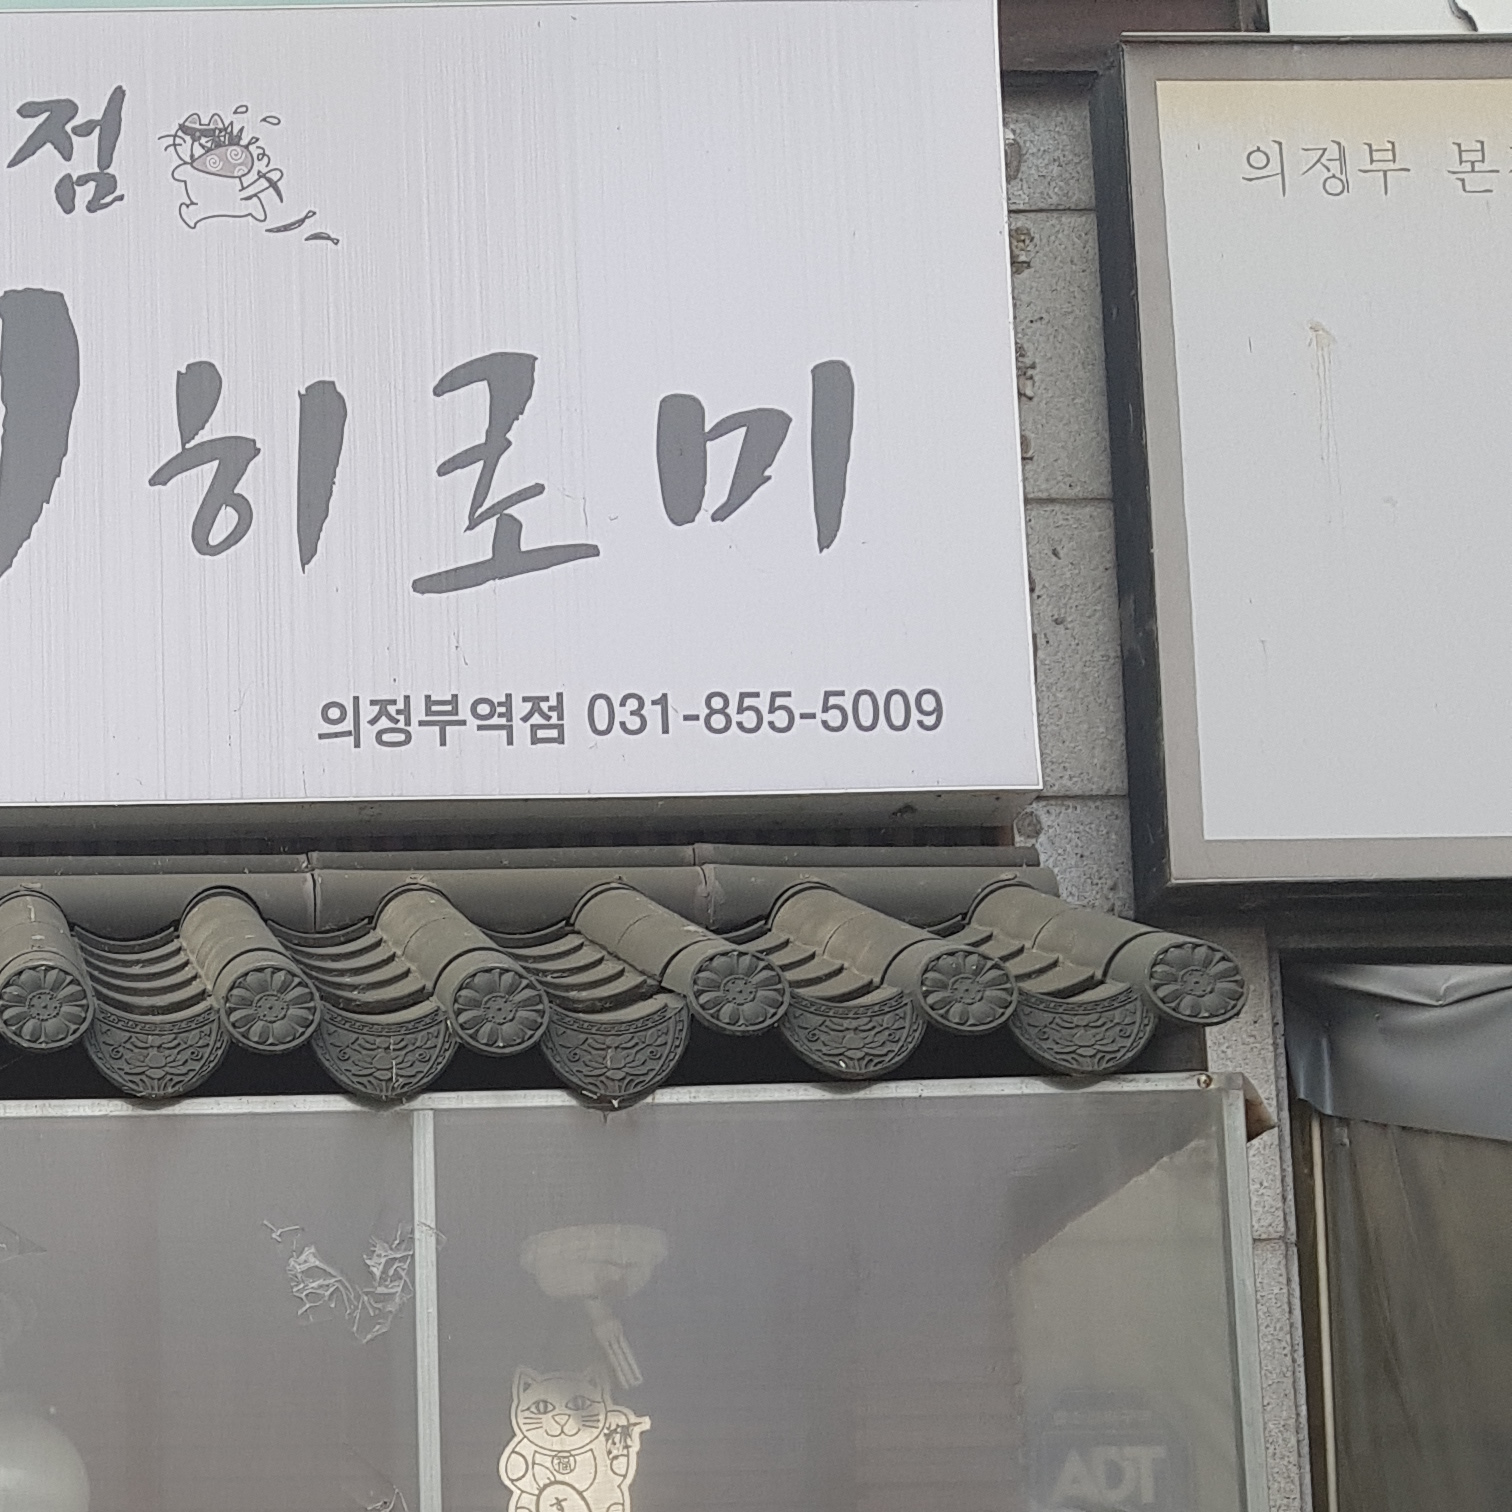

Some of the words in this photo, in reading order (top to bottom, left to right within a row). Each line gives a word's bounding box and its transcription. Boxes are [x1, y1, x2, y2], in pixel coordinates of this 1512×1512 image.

[1242, 140, 1411, 198] 의정부
[1447, 140, 1512, 195] 본
[316, 693, 568, 748] 의정부역점
[588, 688, 944, 736] 031-855-5009
